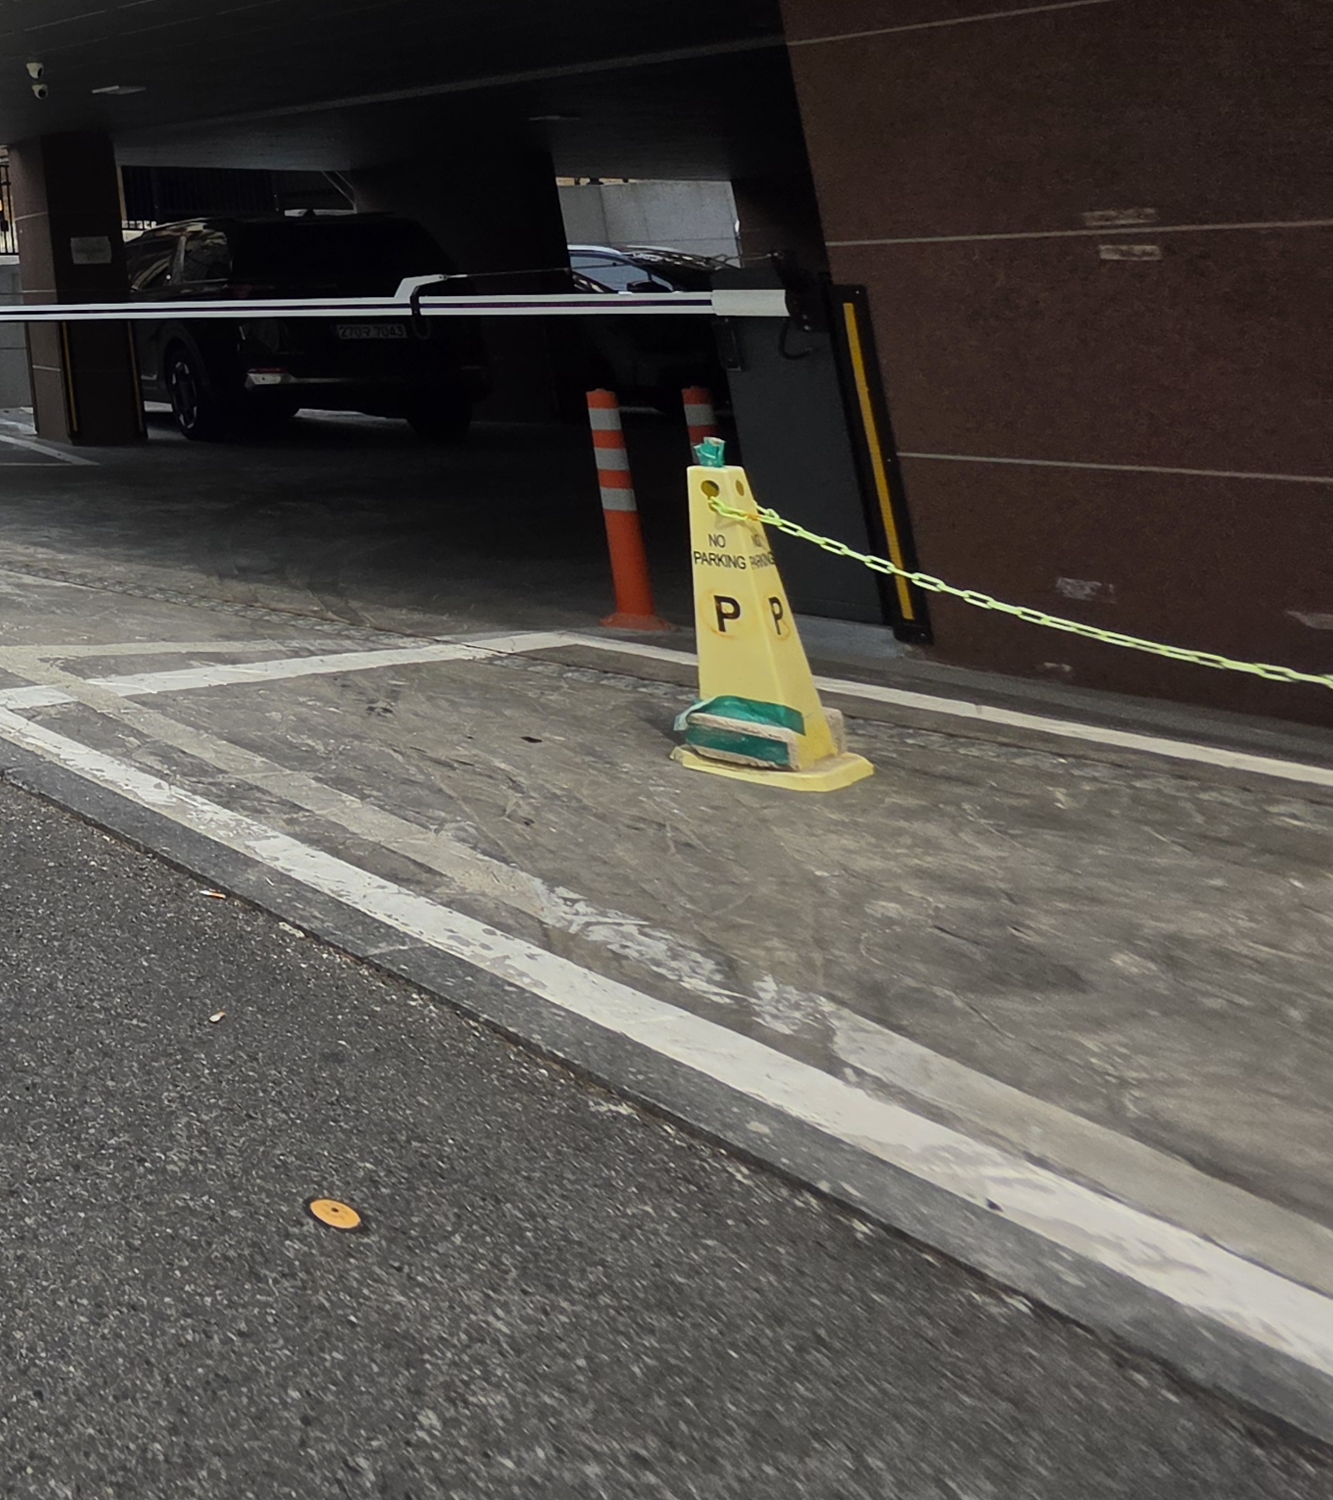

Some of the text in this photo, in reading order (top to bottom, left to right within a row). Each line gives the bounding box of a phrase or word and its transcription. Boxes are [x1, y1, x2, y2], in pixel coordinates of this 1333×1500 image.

[708, 533, 726, 548] NO
[693, 551, 747, 570] PARKING
[713, 595, 741, 633] P
[768, 596, 783, 636] P
